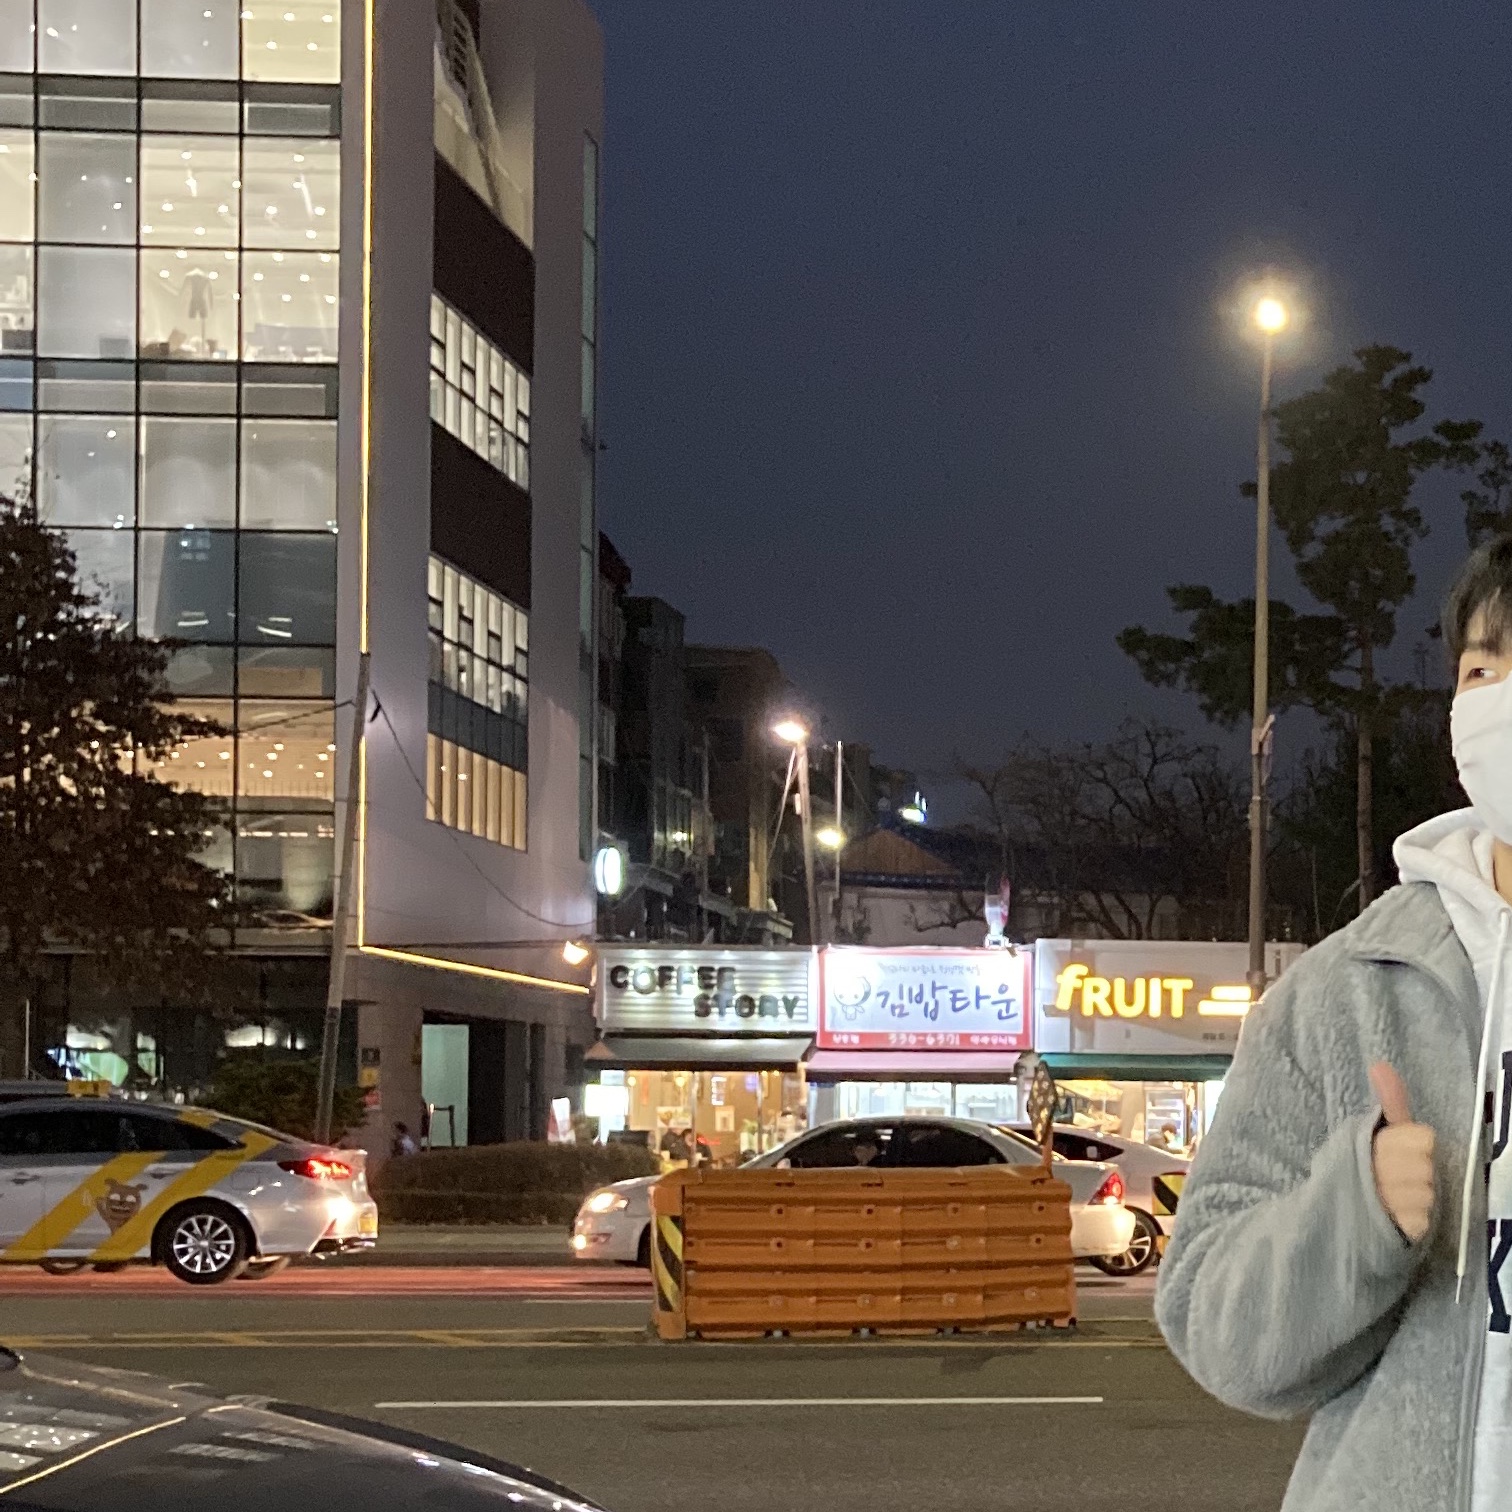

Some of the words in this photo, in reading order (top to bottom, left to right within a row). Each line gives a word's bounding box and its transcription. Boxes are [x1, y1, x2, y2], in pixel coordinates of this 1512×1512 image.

[610, 965, 737, 995] COFFEE
[694, 992, 800, 1019] STORY
[876, 980, 1018, 1021] 김밥타운
